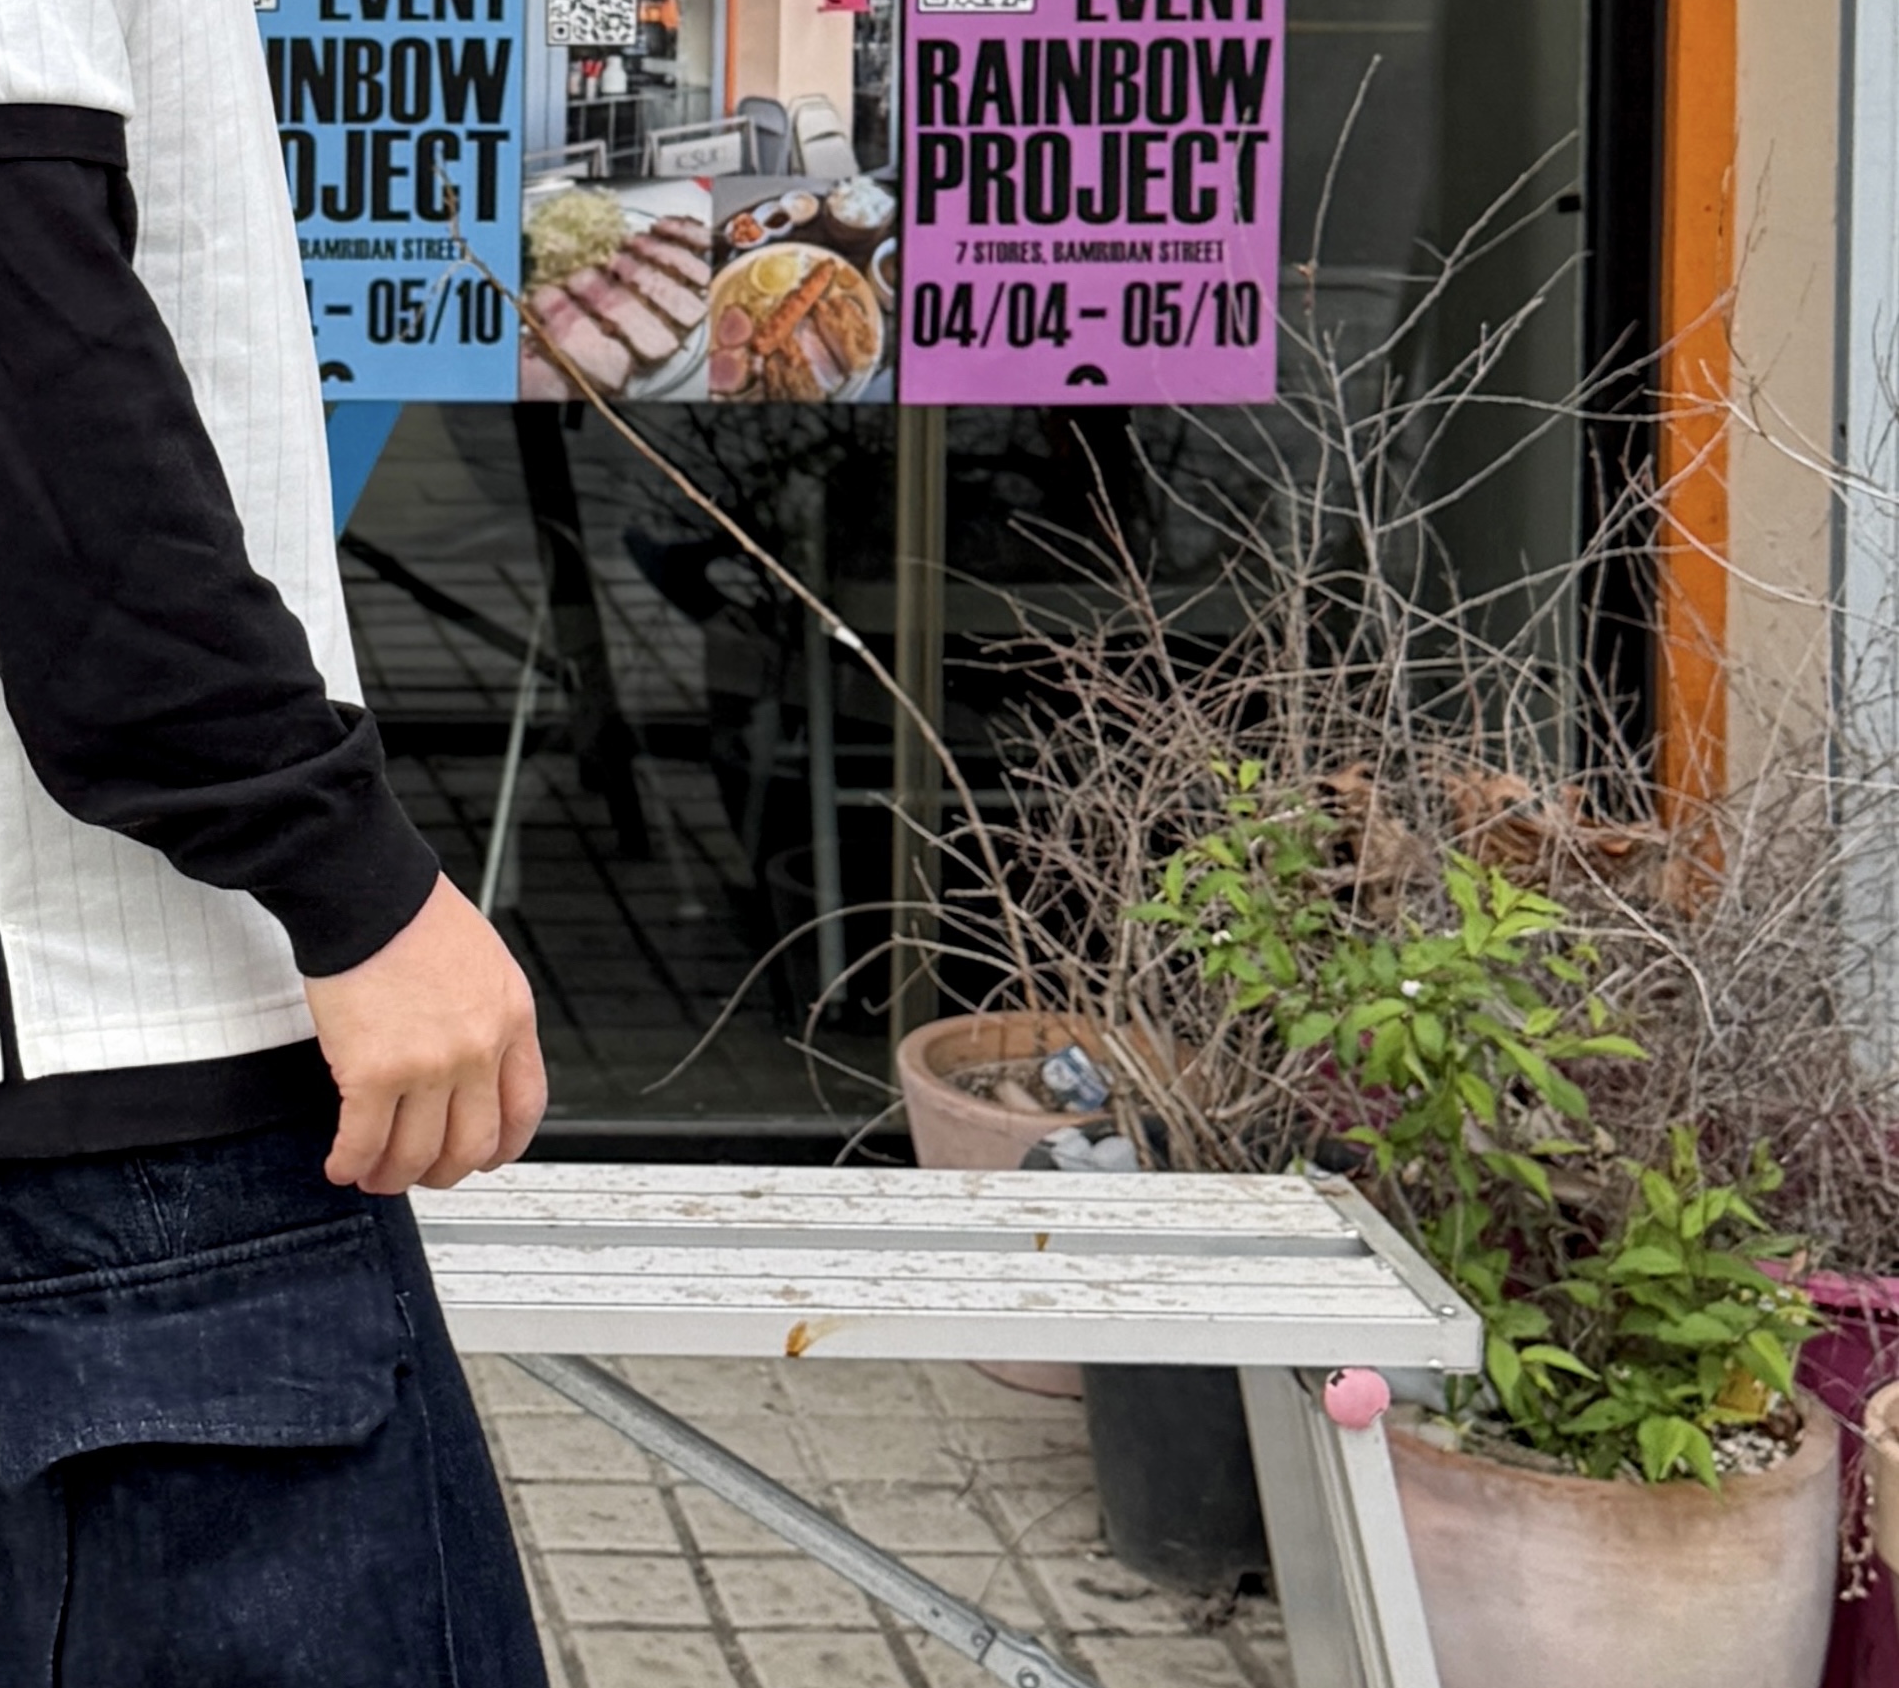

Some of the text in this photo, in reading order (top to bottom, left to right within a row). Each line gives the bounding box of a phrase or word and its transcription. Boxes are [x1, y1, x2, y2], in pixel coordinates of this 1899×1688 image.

[269, 38, 512, 124] INBOW
[916, 37, 1272, 128] RAINBOW
[915, 130, 1270, 226] PROJECT
[402, 235, 469, 261] STREET
[956, 240, 1223, 265] 7 STORES, BAMRIDAN STREET
